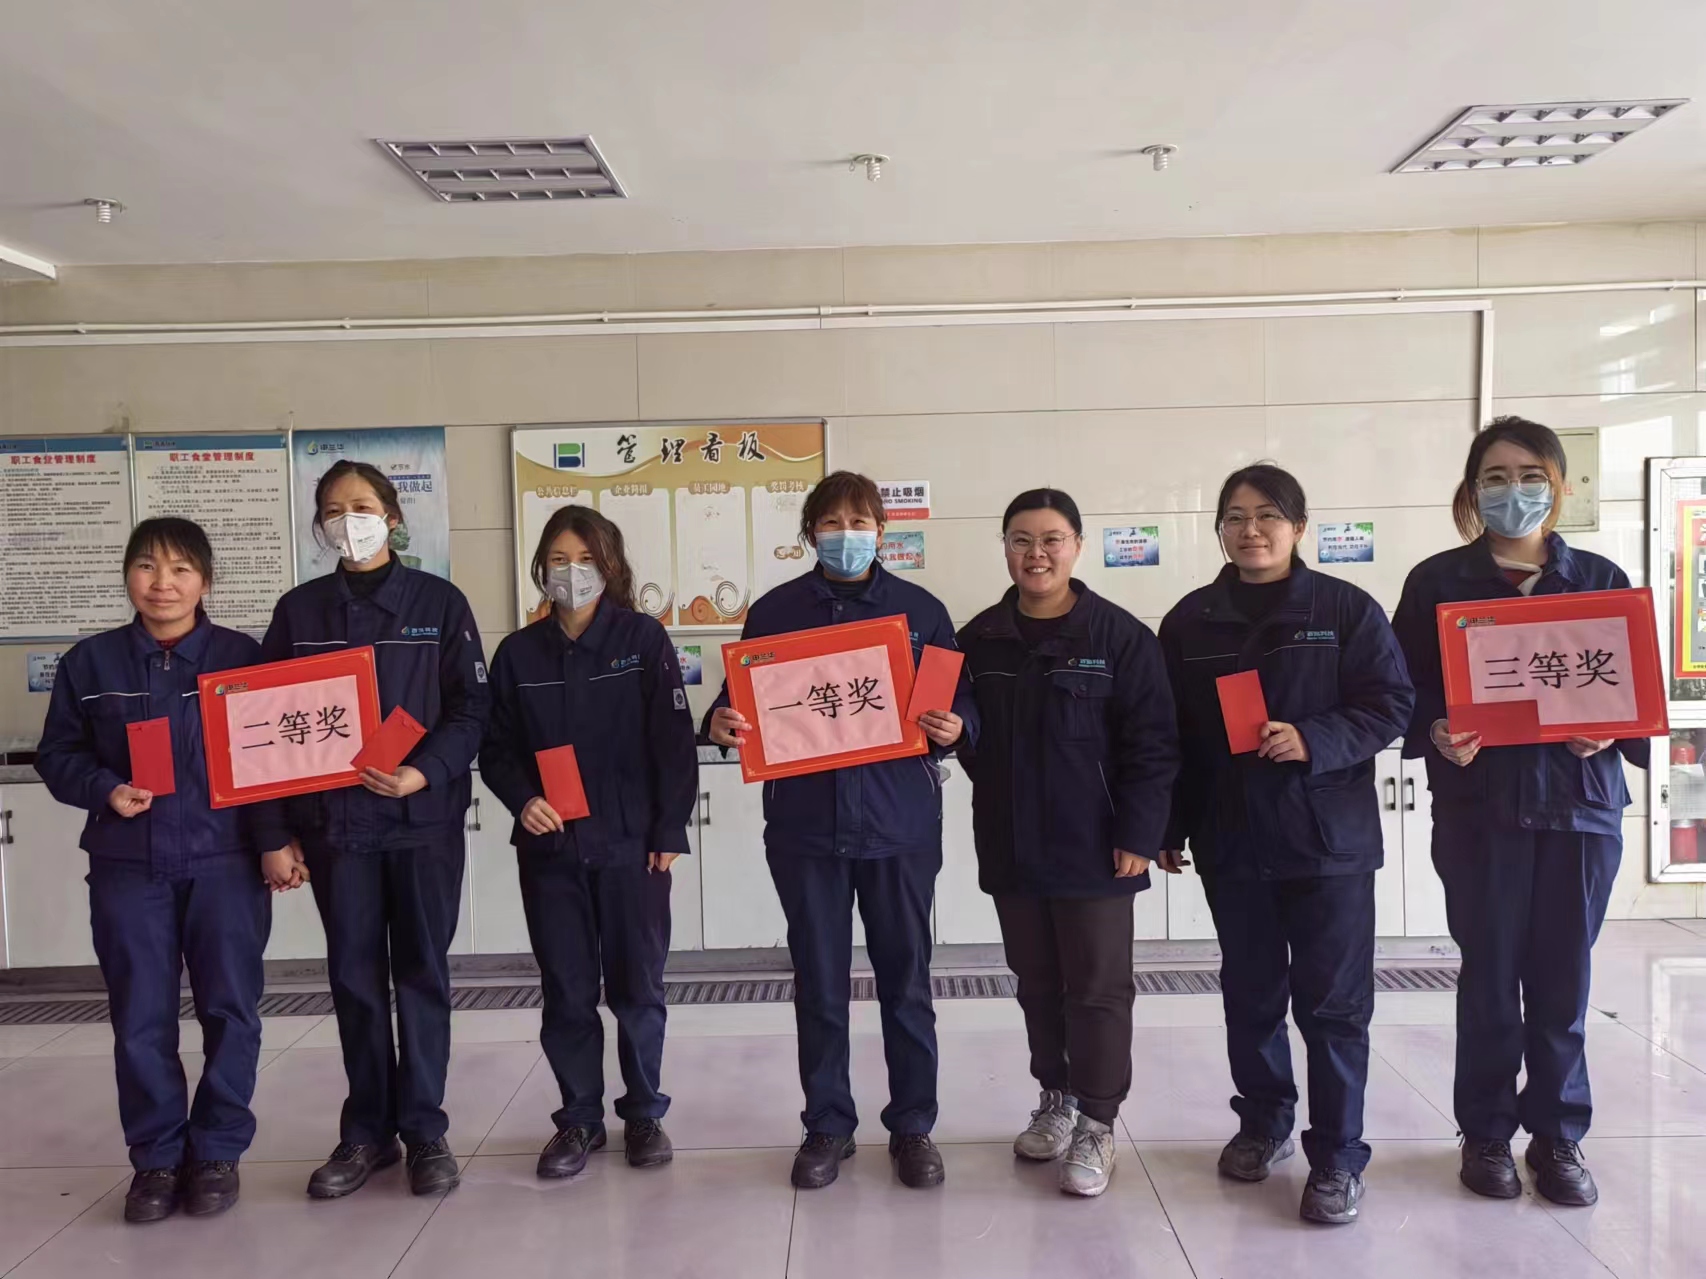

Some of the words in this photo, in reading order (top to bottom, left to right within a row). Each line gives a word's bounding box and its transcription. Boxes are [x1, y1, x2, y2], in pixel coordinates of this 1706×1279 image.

[616, 431, 765, 464] 管理看板
[11, 454, 96, 465] 职工食堂管理制度
[169, 451, 255, 462] 职工食堂管理制度
[394, 480, 433, 493] 我做起
[693, 482, 727, 494] 员工园地
[769, 480, 804, 492] 奖罚考核
[881, 487, 925, 498] 禁止吸烟
[1484, 648, 1620, 689] 三等奖
[769, 675, 886, 719] 一等奖
[241, 705, 351, 749] 二等奖
